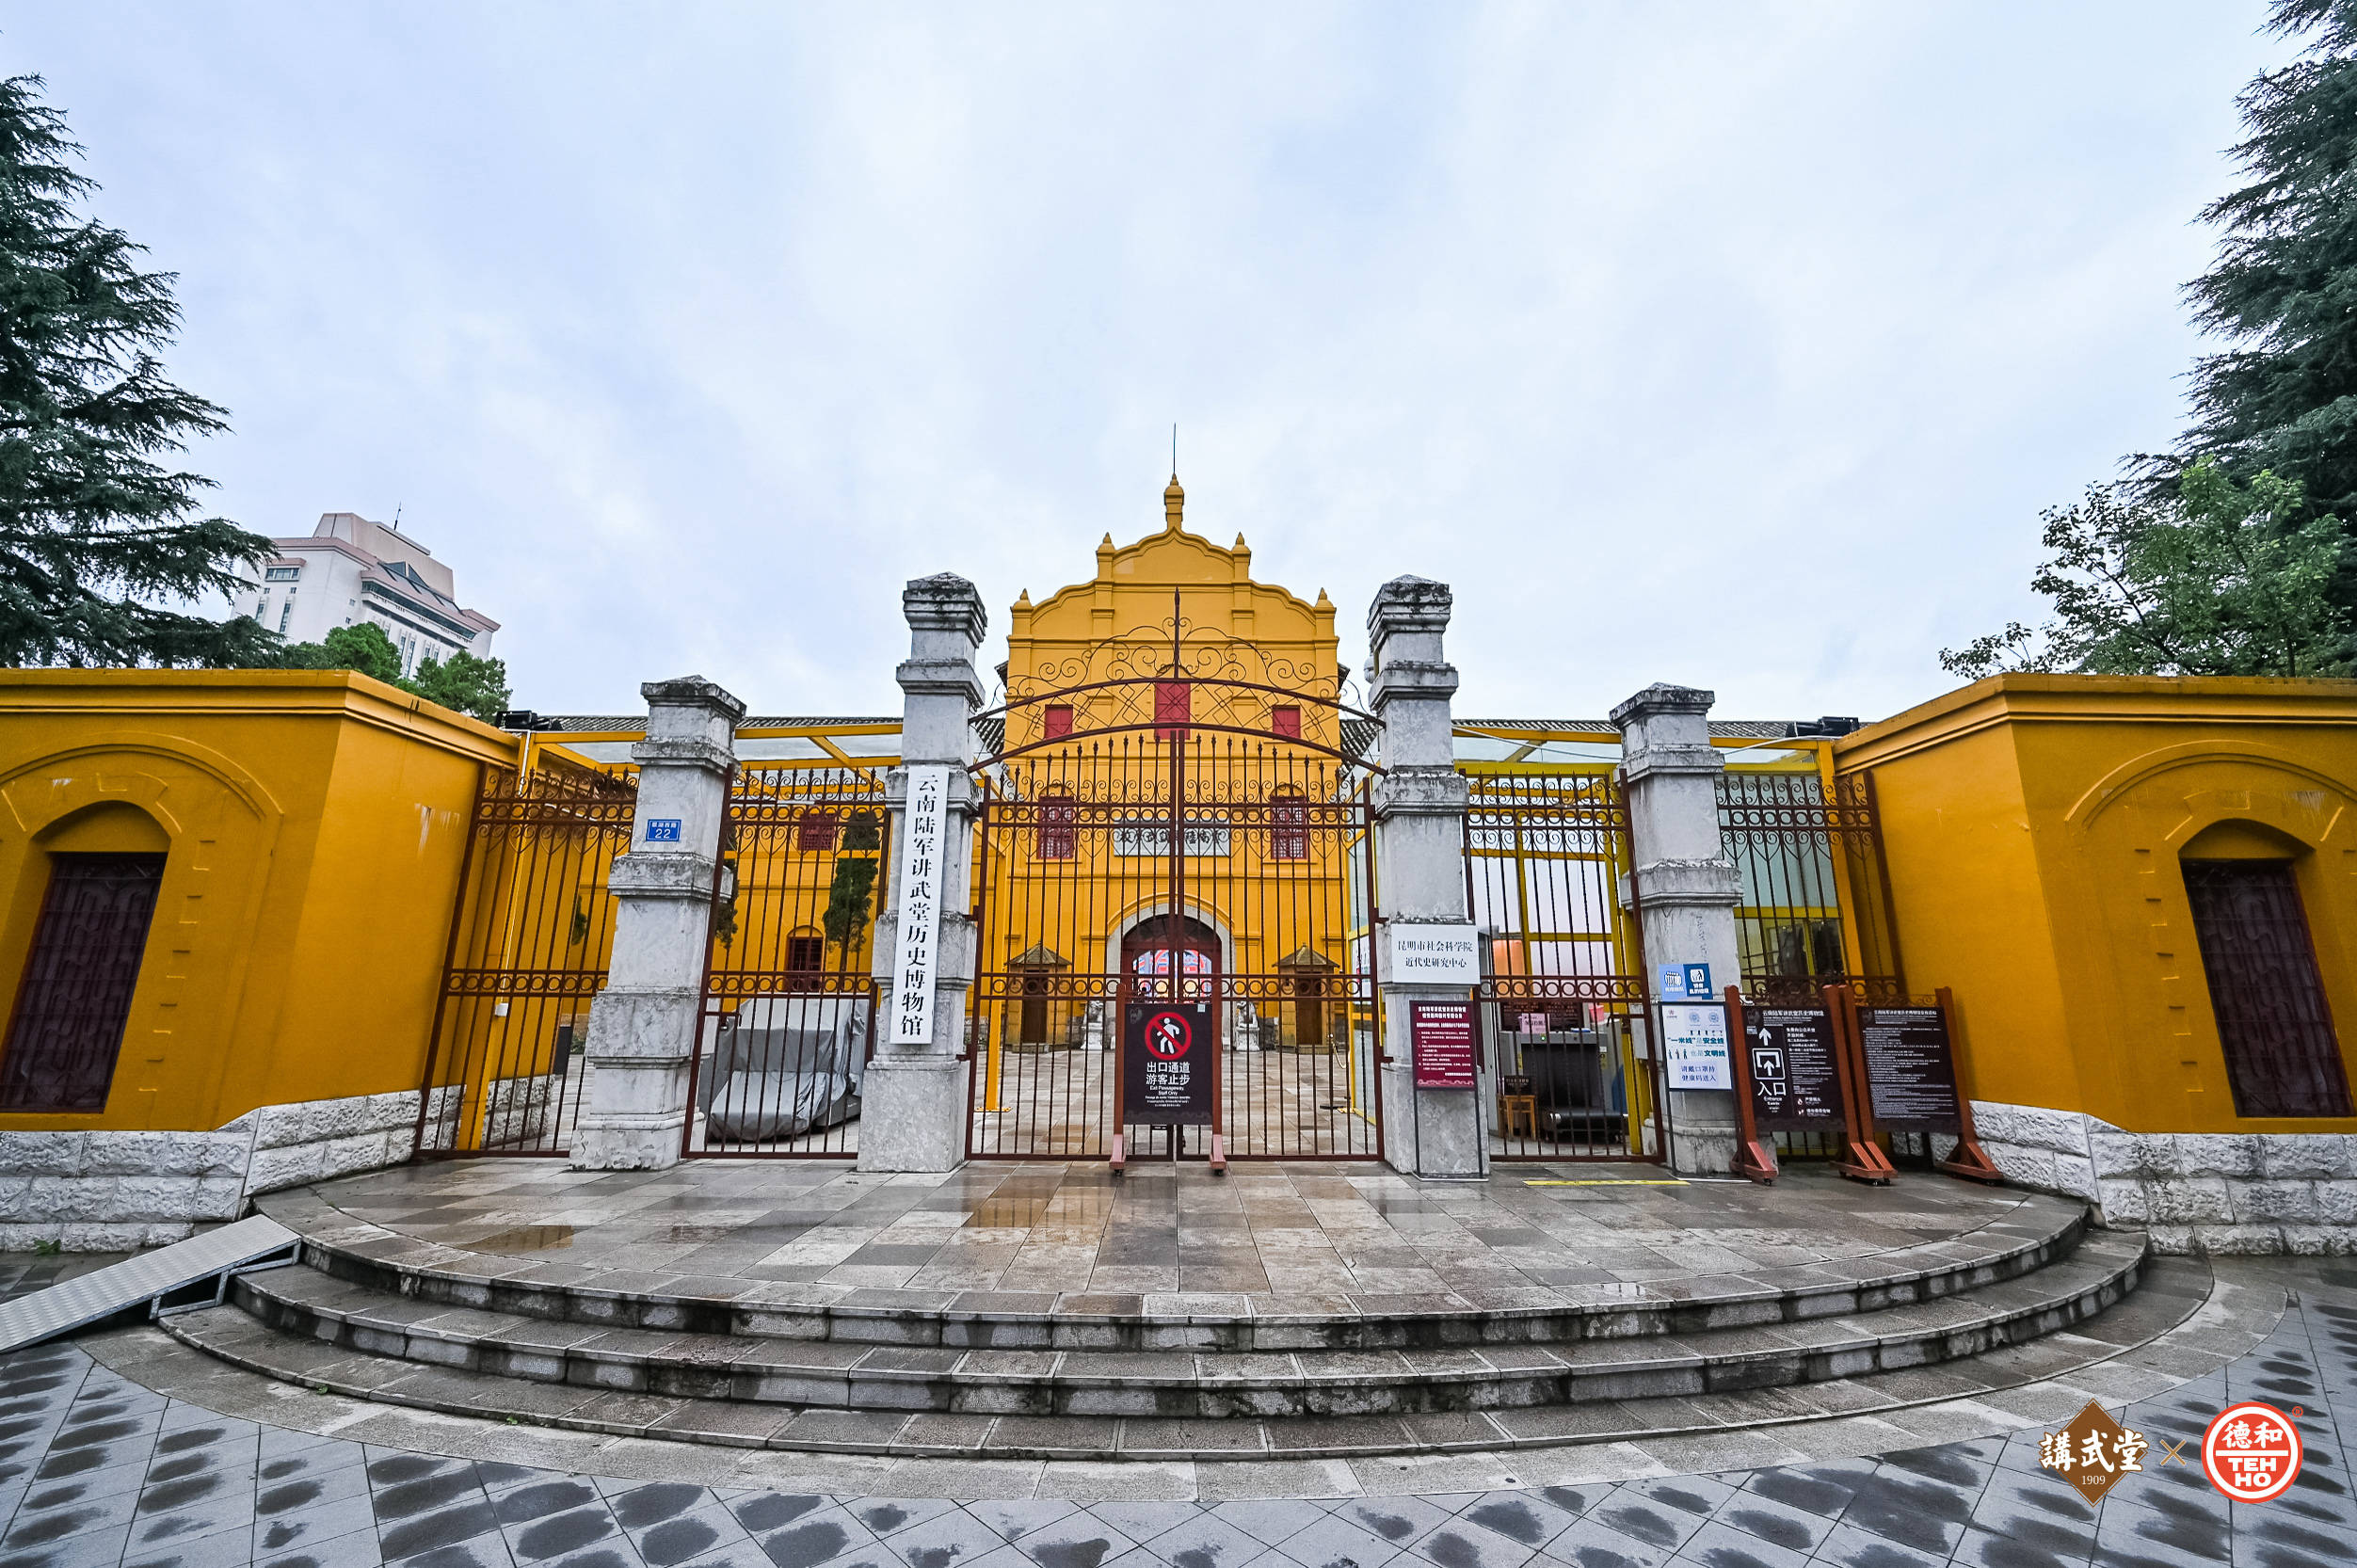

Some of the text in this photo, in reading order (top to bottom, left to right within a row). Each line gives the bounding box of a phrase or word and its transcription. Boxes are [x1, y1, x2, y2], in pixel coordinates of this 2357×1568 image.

[655, 828, 671, 839] 22
[900, 774, 938, 1036] 云南陆军讲武堂历史博物馆
[1398, 940, 1473, 952] 昆明市社会科学院
[1405, 956, 1467, 968] 近代史研究中心
[1146, 1061, 1191, 1073] 出口通道
[1146, 1073, 1191, 1085] 游客止步
[1757, 1080, 1787, 1096] 入口
